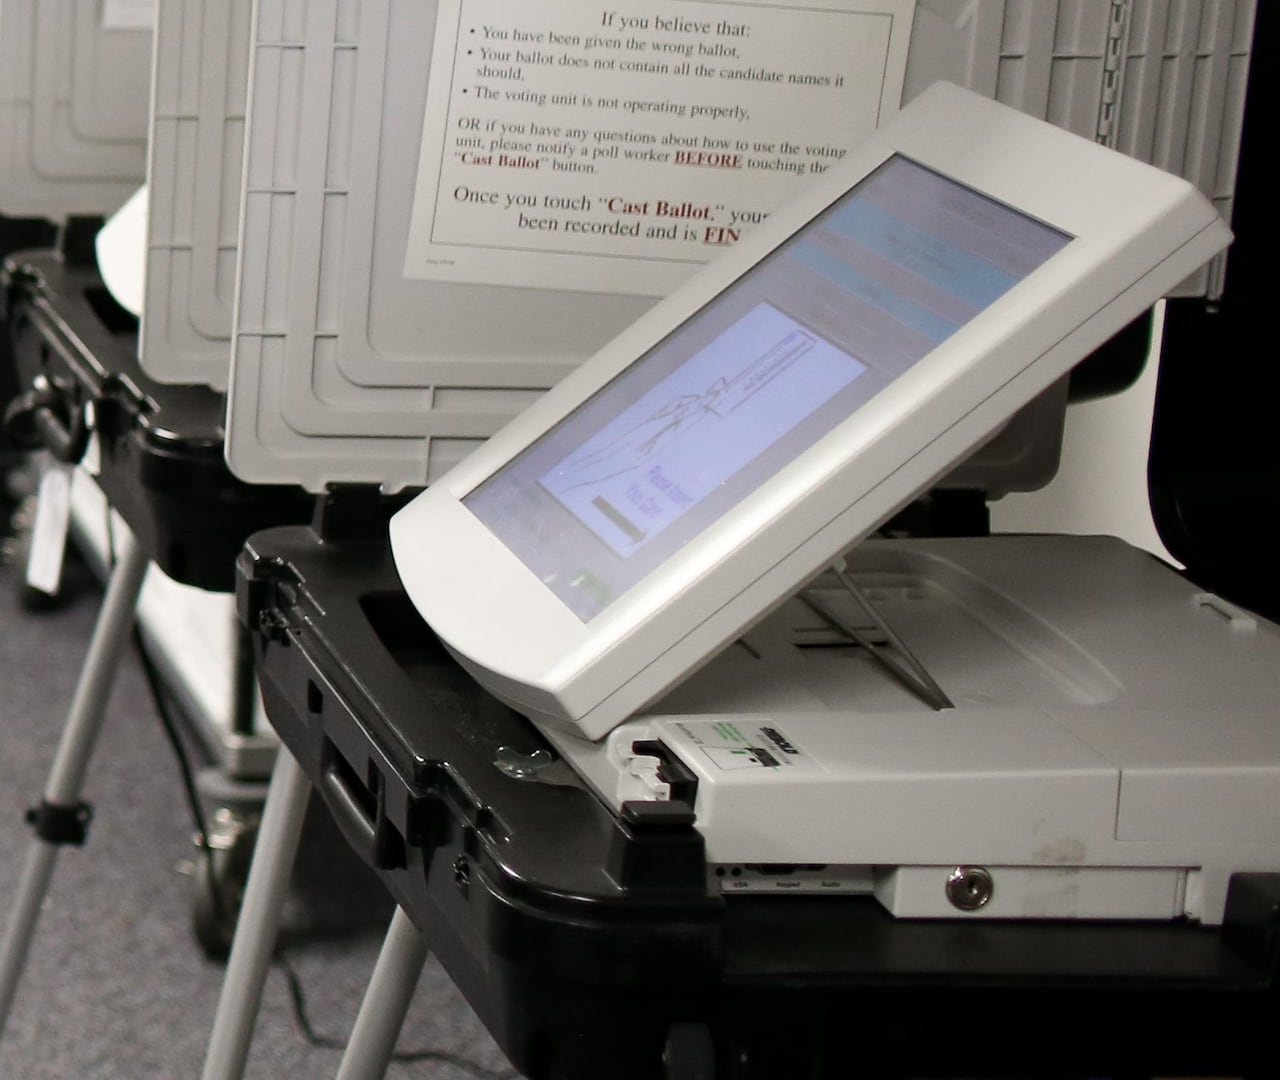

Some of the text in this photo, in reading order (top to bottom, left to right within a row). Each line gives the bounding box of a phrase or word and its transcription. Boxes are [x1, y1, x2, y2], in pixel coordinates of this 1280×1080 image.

[602, 12, 751, 38] If you believe that:
[483, 26, 508, 40] You
[513, 28, 544, 43] have
[549, 31, 580, 45] been
[585, 35, 621, 50] given
[626, 36, 648, 51] the
[652, 42, 693, 57] wrong
[480, 48, 844, 87] Your ballot does not contain all the candidate names it
[475, 86, 500, 100] The
[505, 91, 547, 105] voting
[552, 92, 577, 106] unit
[583, 94, 592, 106] is
[598, 96, 619, 109] not
[623, 100, 686, 117] operating
[458, 117, 847, 160] OR if you have any questions about how to use the voting
[490, 138, 532, 153] please
[536, 142, 576, 158] notify
[581, 149, 588, 157] a
[592, 146, 619, 161] poll
[624, 149, 671, 163] worker
[674, 150, 743, 169] BEFORE
[747, 157, 805, 175] touching
[454, 185, 499, 204] Once
[504, 193, 538, 210] you
[544, 194, 591, 211] touch
[598, 196, 649, 216] "Cast
[517, 213, 741, 246] been recorded and is FIN
